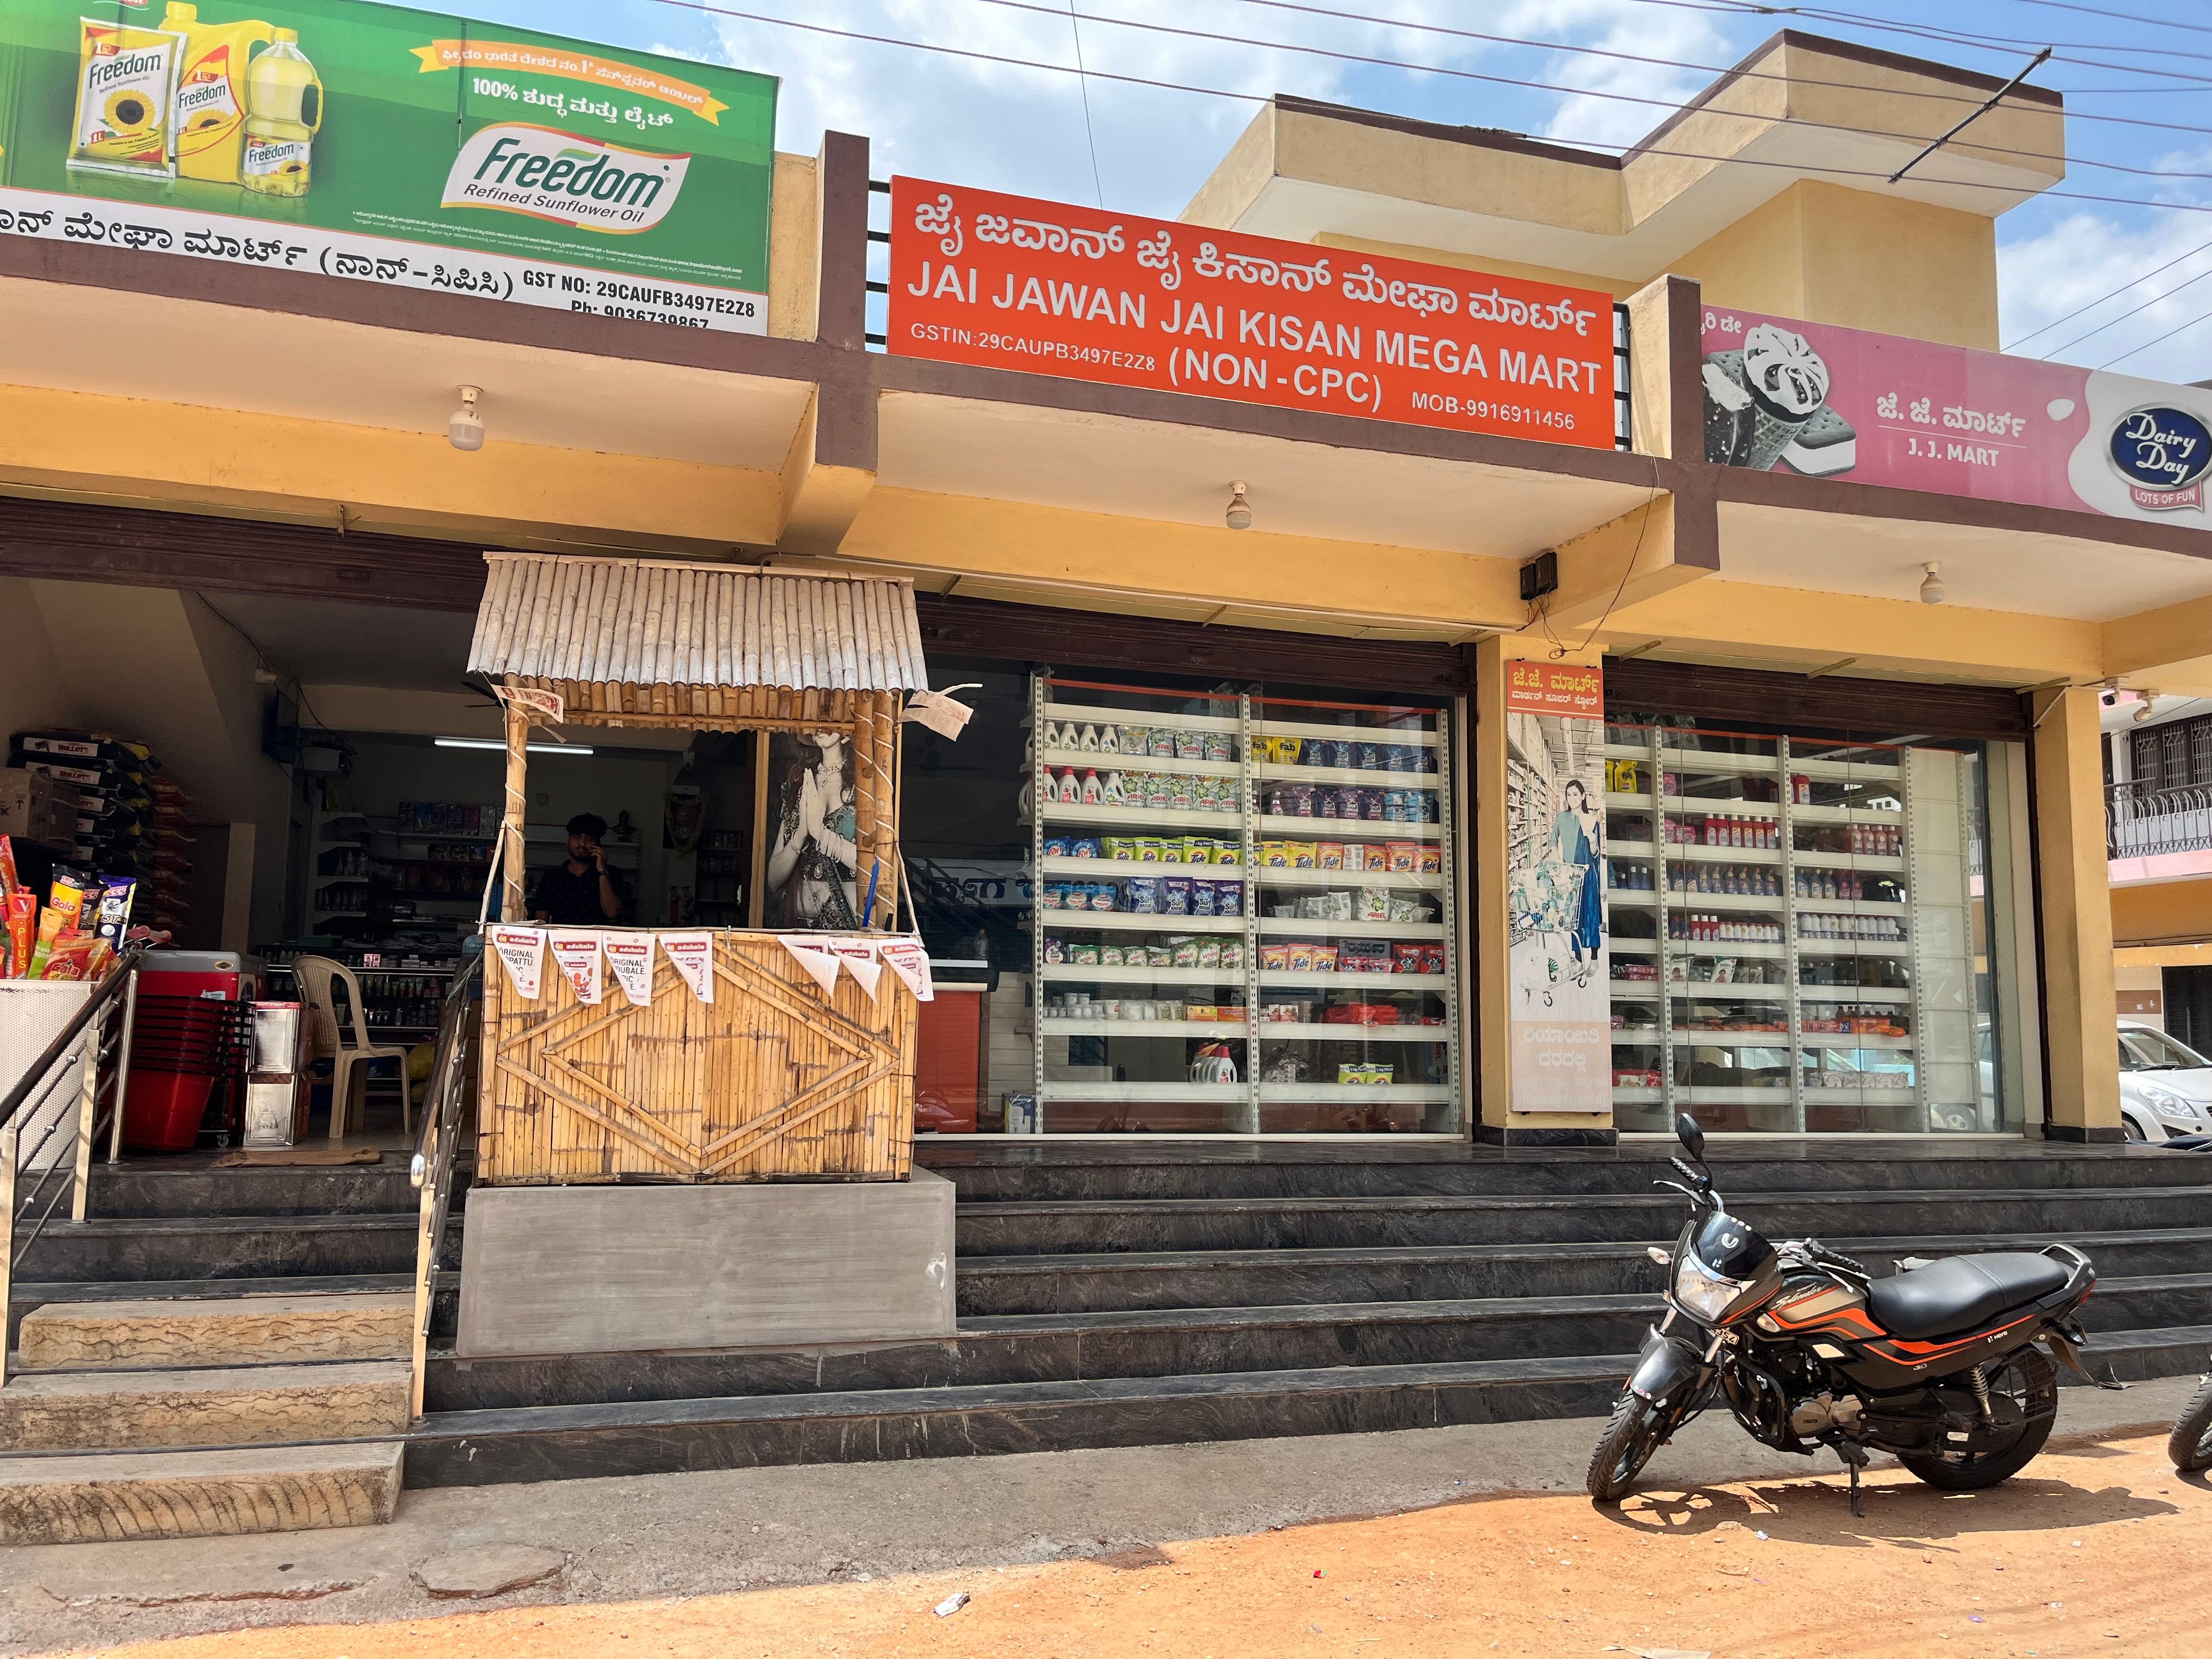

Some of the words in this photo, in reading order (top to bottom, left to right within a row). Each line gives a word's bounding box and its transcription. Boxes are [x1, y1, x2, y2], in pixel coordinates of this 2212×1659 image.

[485, 52, 517, 63] ಭಾರತ
[520, 54, 556, 67] ದೇಶದ
[89, 54, 161, 89] Freedom
[179, 84, 226, 109] Freedom
[473, 78, 518, 101] 100%
[569, 97, 618, 123] ಮತ್ತು
[624, 106, 673, 130] ಲೈಟ್
[249, 144, 294, 163] Freedom
[474, 138, 669, 208] Freedom
[464, 184, 530, 206] Refined
[533, 195, 618, 219] Sunflower
[621, 206, 645, 223] Oil
[64, 212, 172, 250] ಮೇಘಾ
[184, 229, 307, 266] ಮಾರ್ಟ್
[915, 193, 963, 257] ಜೈ
[975, 213, 1125, 259] ಜವಾನ್
[1137, 230, 1181, 291] ಜೈ
[1193, 241, 1332, 293] ಕಿಸಾನ್
[1342, 263, 1458, 319] ಮೇಘಾ
[1469, 287, 1596, 336] ಮಾರ್ಟ್
[523, 270, 556, 289] GST
[561, 275, 591, 294] NO:
[596, 281, 755, 317] 29CAUFB3497E2Z8
[907, 261, 977, 304] JAI
[992, 273, 1146, 329] JAWAN
[1161, 299, 1223, 340] JAI
[1239, 309, 1361, 360] KISAN
[1376, 329, 1488, 379] MEGA
[1500, 348, 1601, 395] MART
[1412, 392, 1575, 430] MOB-9916911456
[1943, 405, 2025, 437] ಮಾರ್ಟ್
[2125, 413, 2196, 458] Dairy
[1908, 438, 1922, 456] J.
[1928, 441, 1942, 459] J.
[1948, 443, 1999, 466] MART
[2136, 441, 2189, 484] Day
[2135, 489, 2159, 504] LOTS
[2162, 495, 2174, 504] OF
[2177, 489, 2196, 502] FUN
[1550, 672, 1599, 693] ಮಾರ್ಟ್
[1252, 742, 1267, 750] fab
[1279, 742, 1295, 751] fab
[1190, 855, 1206, 863] Tide
[1268, 857, 1286, 866] Tide
[1295, 857, 1313, 867] Tide
[1323, 856, 1339, 868] Tide
[1369, 858, 1383, 869] Tide
[1395, 858, 1409, 869] Tide
[1421, 861, 1436, 872] Tide
[52, 897, 75, 911] Gala
[499, 948, 534, 958] ORIGINAL
[1224, 951, 1239, 960] Wheel
[610, 957, 644, 967] ORIGINAL
[1268, 961, 1282, 970] Tide
[1293, 958, 1308, 968] Tide
[1317, 962, 1332, 970] Tide
[1713, 1328, 1734, 1343] 354
